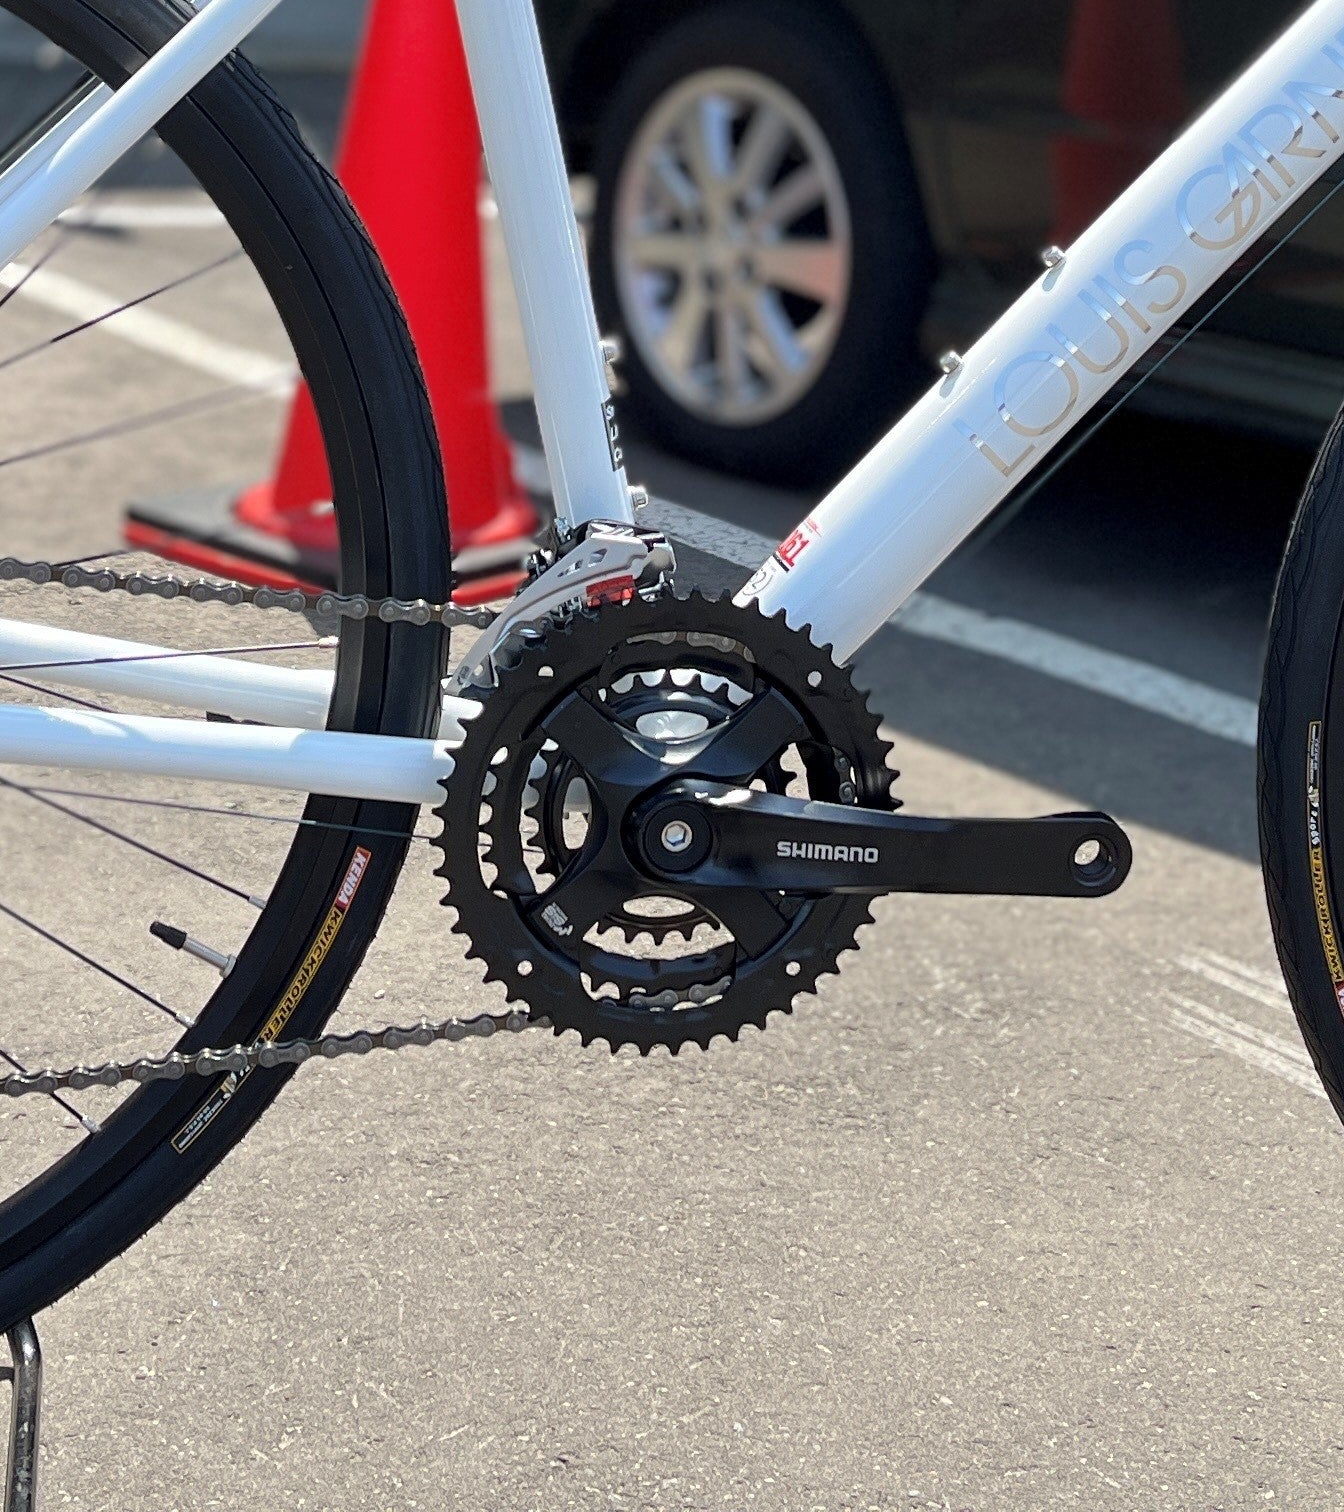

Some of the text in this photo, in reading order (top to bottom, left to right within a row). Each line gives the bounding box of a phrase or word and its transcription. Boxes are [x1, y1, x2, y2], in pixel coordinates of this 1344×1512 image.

[953, 239, 1187, 479] LOUIS
[337, 851, 367, 906] KENDA
[776, 840, 879, 864] SHIMANO
